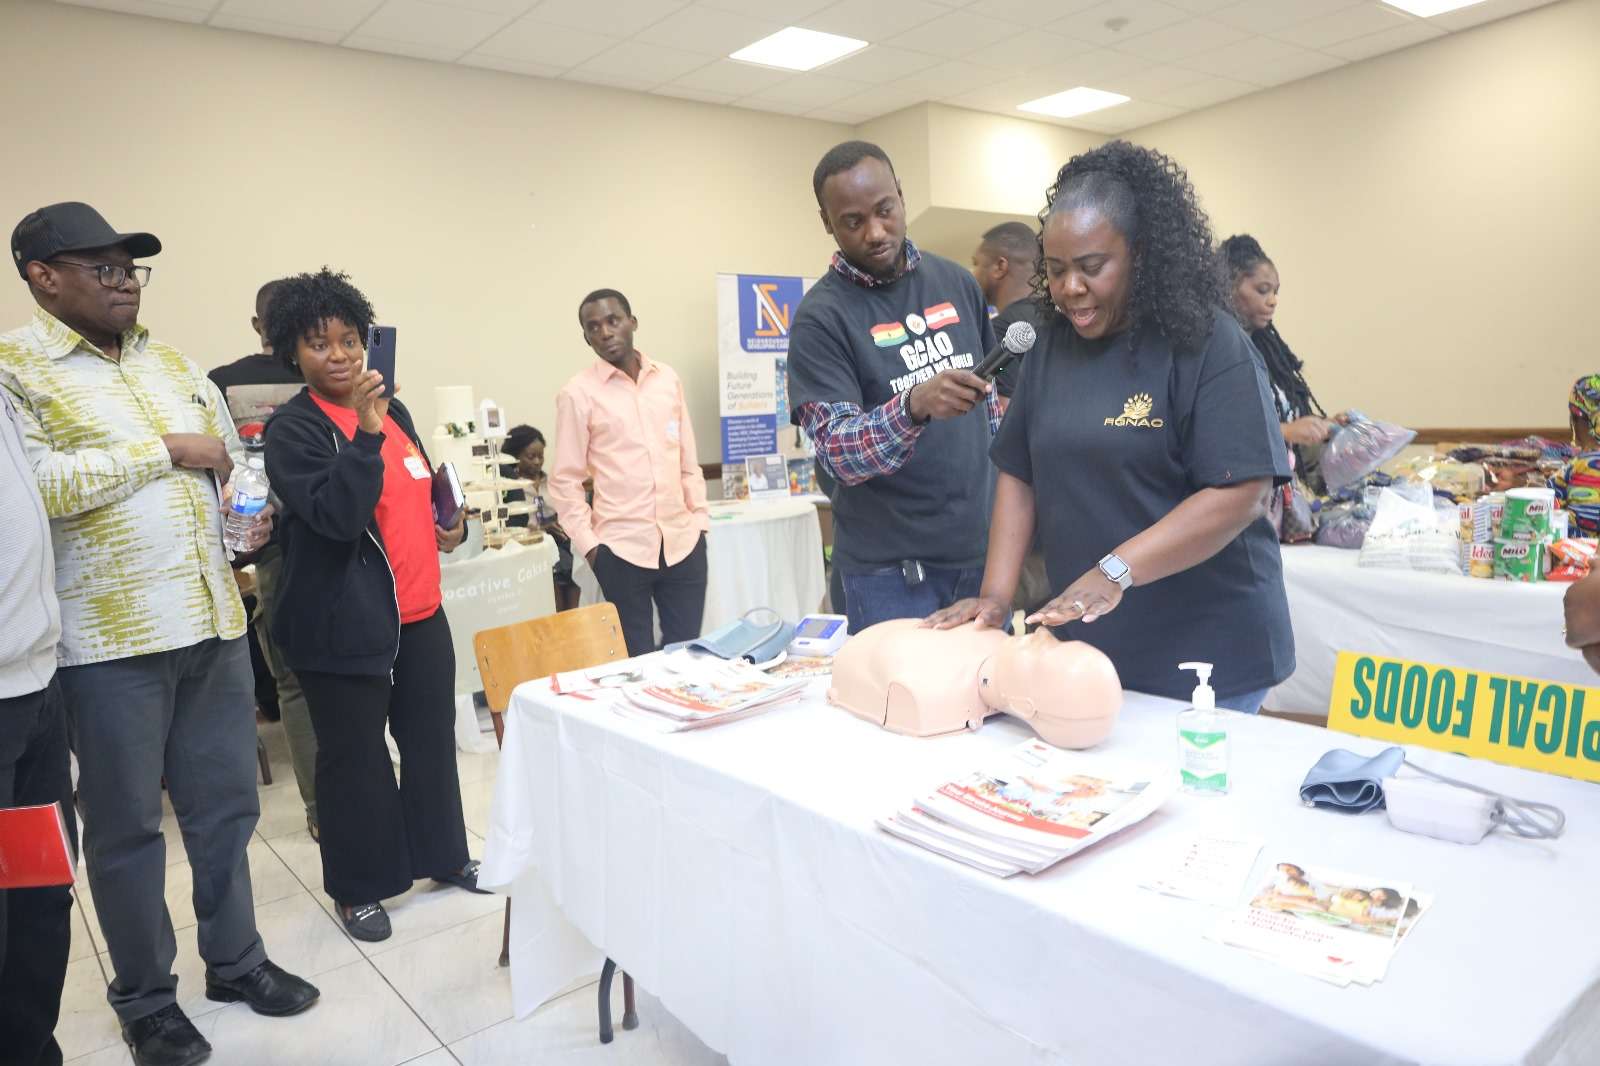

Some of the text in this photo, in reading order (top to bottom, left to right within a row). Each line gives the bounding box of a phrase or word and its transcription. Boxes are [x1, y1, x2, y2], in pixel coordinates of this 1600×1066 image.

[900, 331, 954, 371] GCAO
[727, 371, 758, 382] Building
[727, 381, 752, 390] Future
[1502, 547, 1527, 556] MILO
[1350, 656, 1478, 739] FOODS
